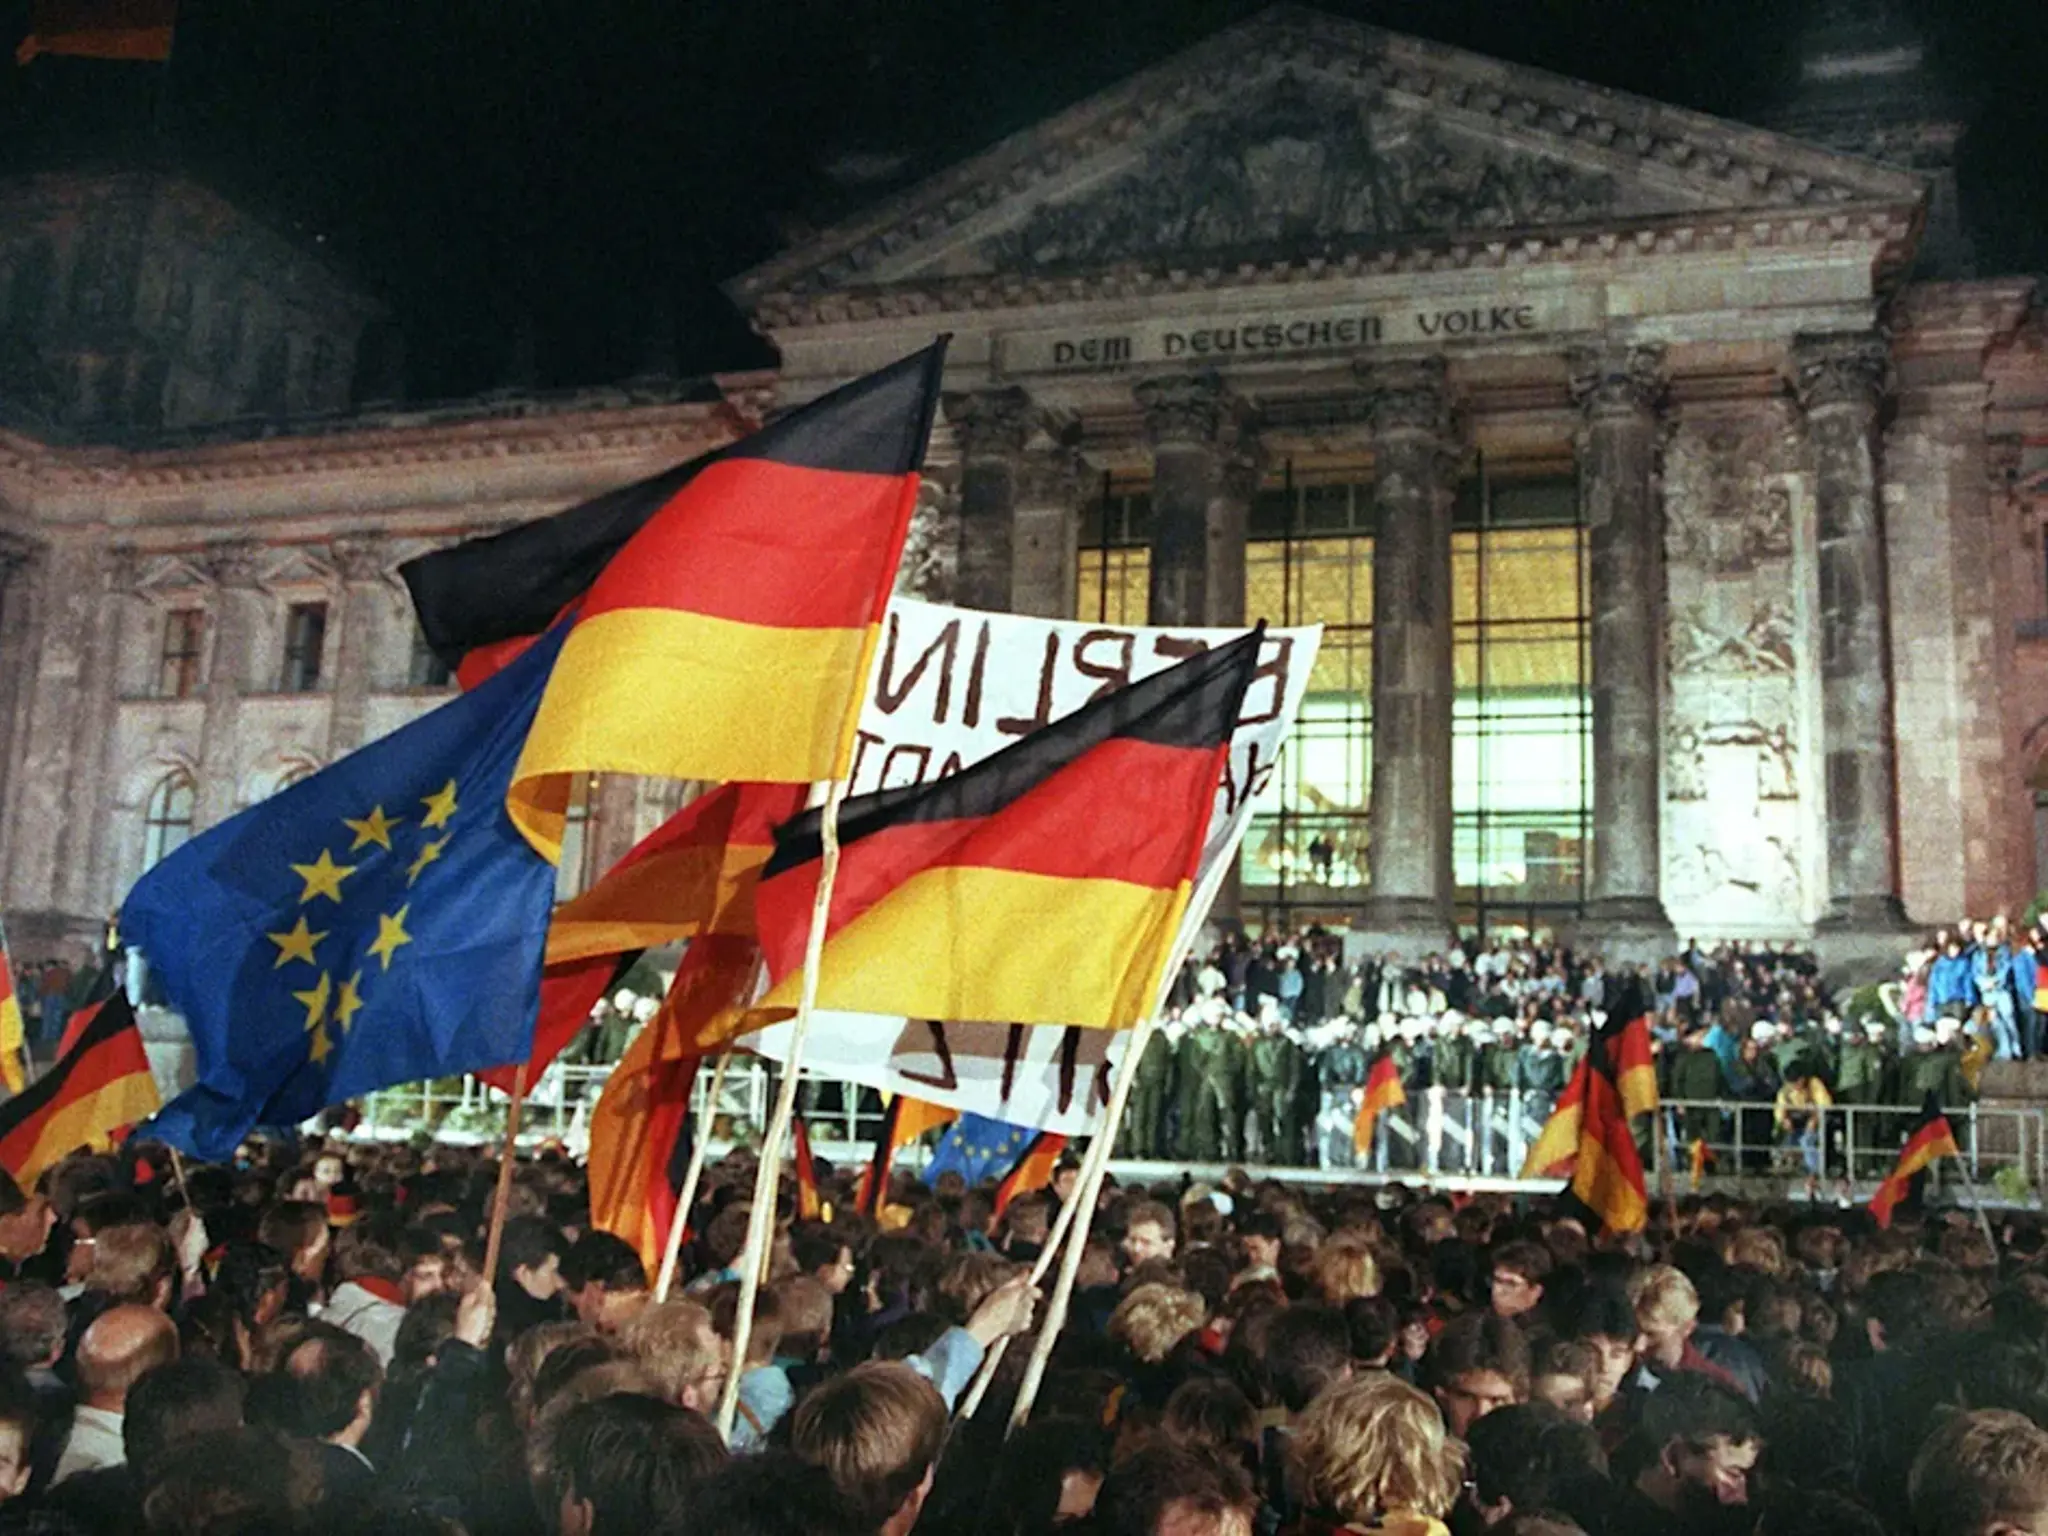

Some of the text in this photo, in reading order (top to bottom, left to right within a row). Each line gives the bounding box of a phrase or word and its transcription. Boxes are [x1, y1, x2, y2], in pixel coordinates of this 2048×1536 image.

[1053, 305, 1533, 364] DEM DEUTSCHEN VOLKE
